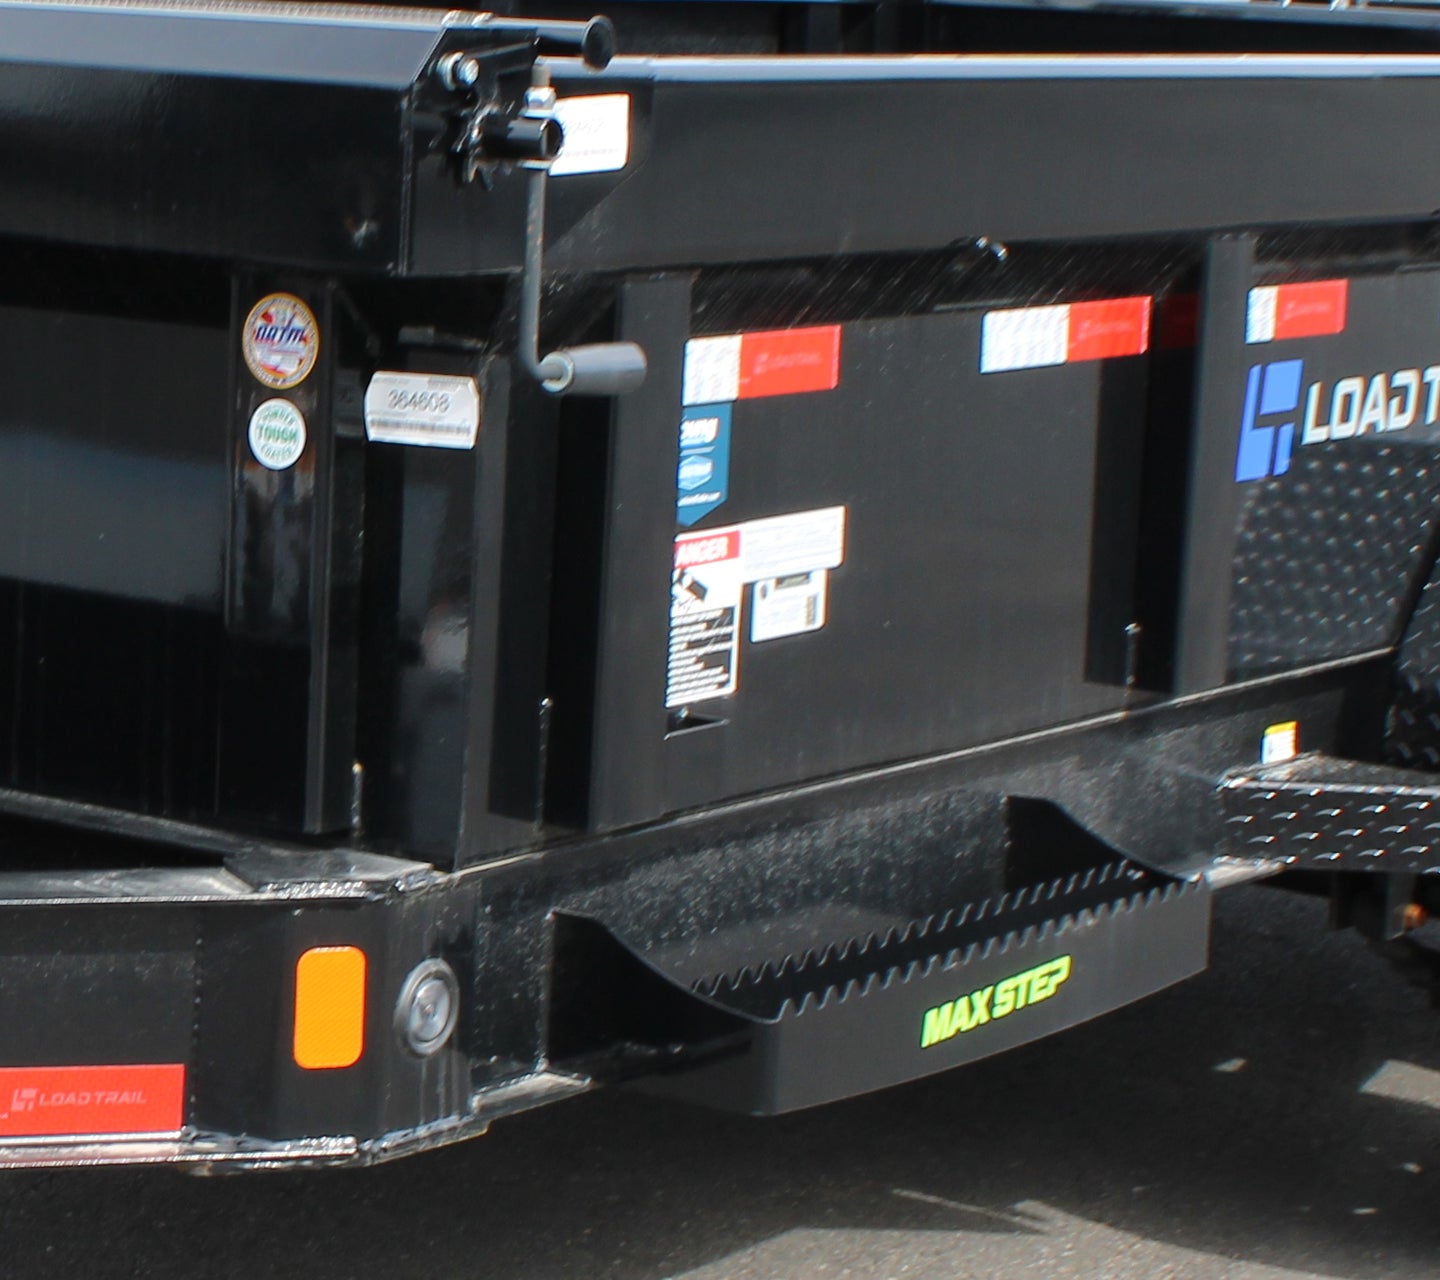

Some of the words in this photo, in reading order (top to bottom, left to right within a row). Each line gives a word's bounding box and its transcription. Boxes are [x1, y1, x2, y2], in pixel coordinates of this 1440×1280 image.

[675, 535, 729, 568] ANGER
[921, 985, 994, 1048] MAX
[991, 954, 1072, 1019] STEP
